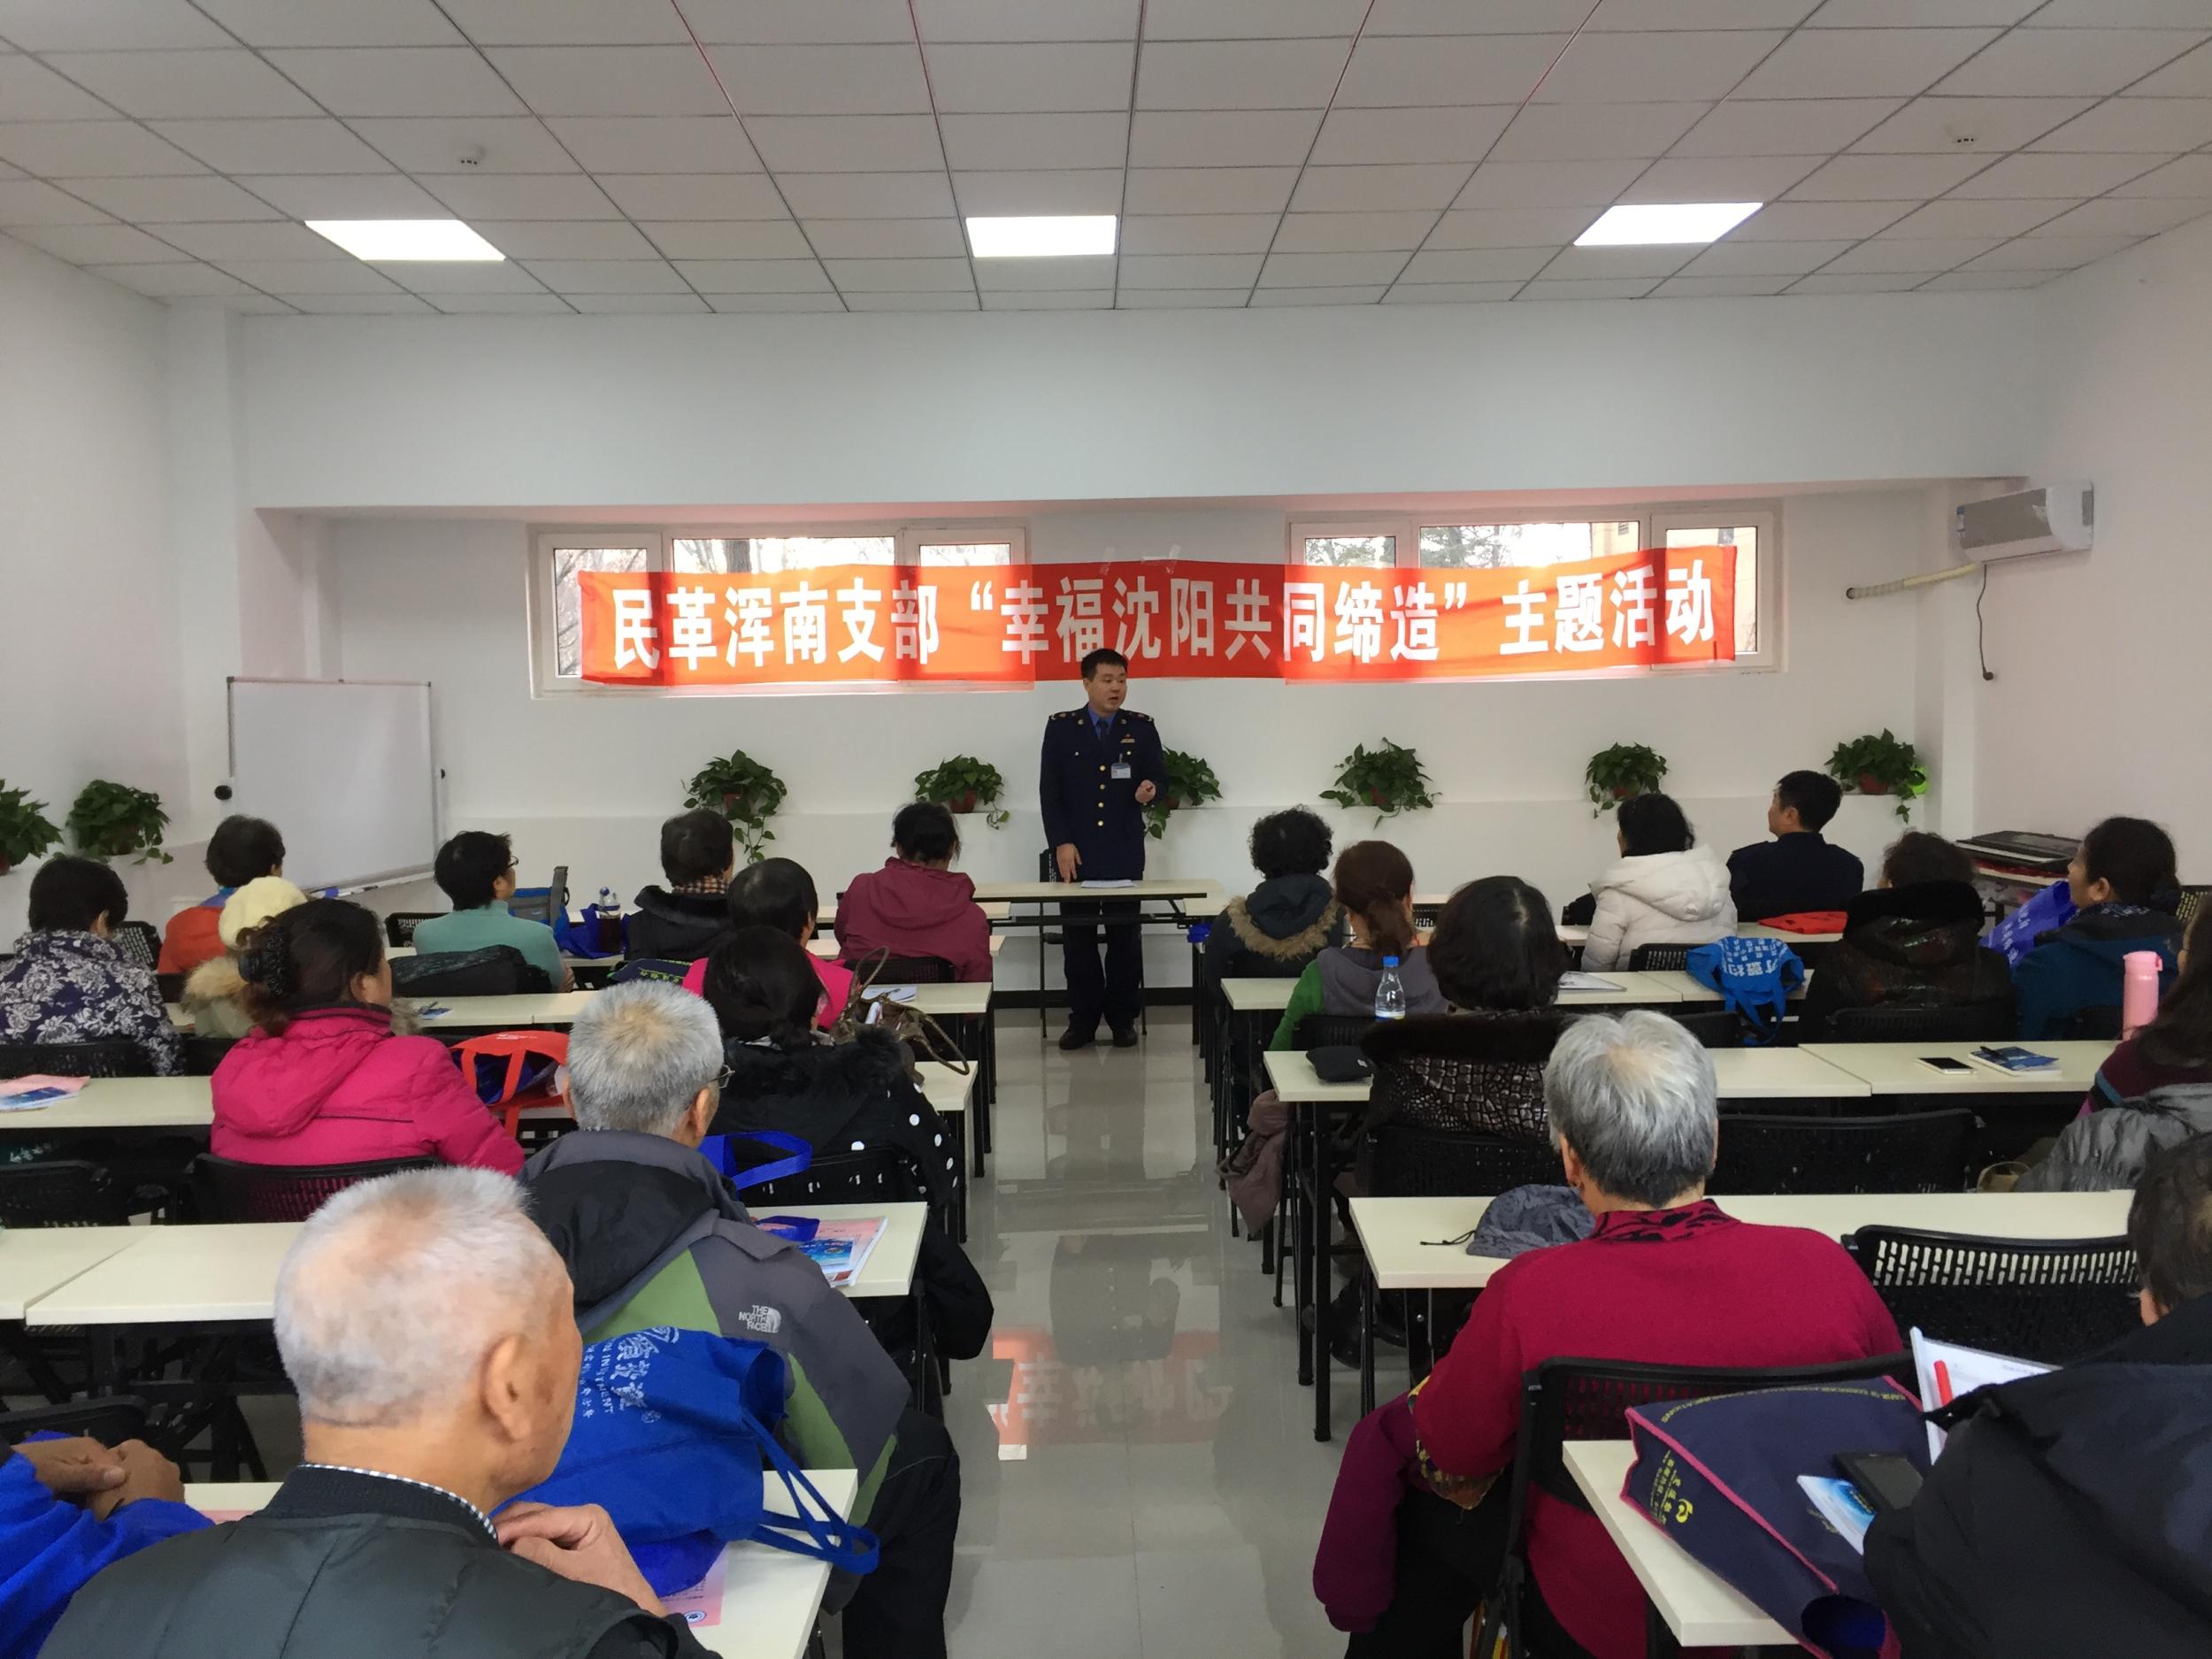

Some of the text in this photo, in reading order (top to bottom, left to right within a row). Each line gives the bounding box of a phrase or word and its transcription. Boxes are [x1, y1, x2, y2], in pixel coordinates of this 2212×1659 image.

[751, 1304, 768, 1315] THE
[738, 1311, 767, 1323] NORTH
[747, 1321, 768, 1332] FACE
